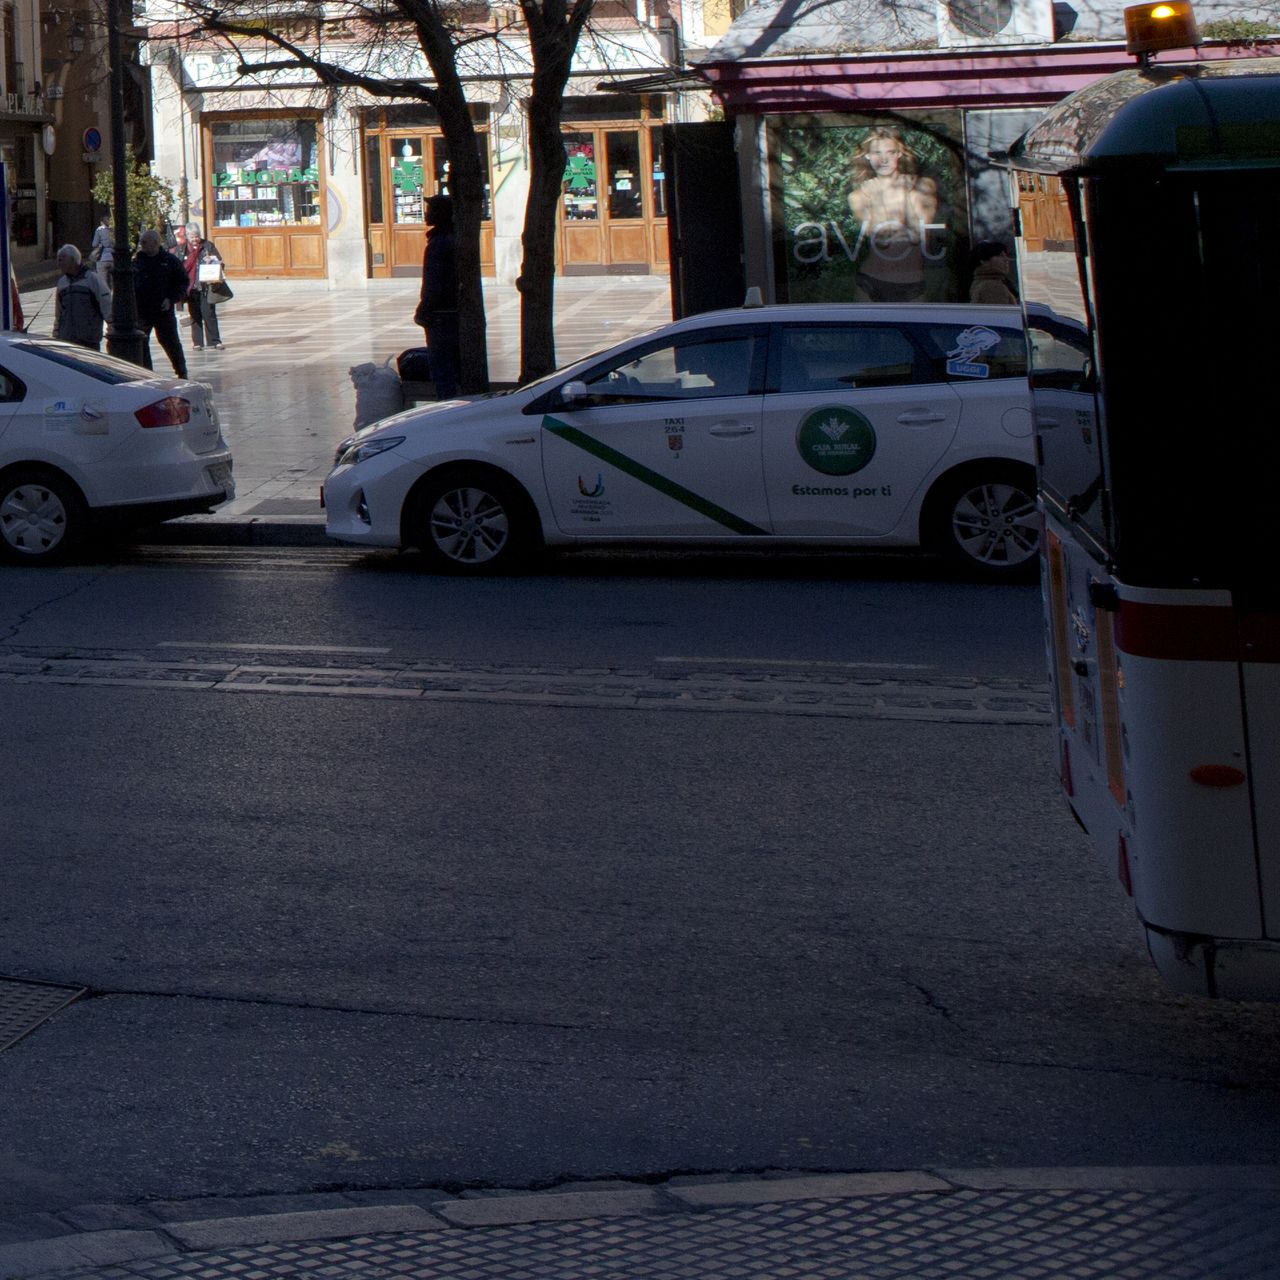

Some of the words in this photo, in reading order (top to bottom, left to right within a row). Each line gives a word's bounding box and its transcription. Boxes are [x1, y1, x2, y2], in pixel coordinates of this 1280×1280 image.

[240, 168, 320, 185] HORAS
[793, 220, 947, 263] avet
[792, 484, 849, 495] Estamos
[853, 486, 875, 498] por
[878, 484, 891, 496] ti
